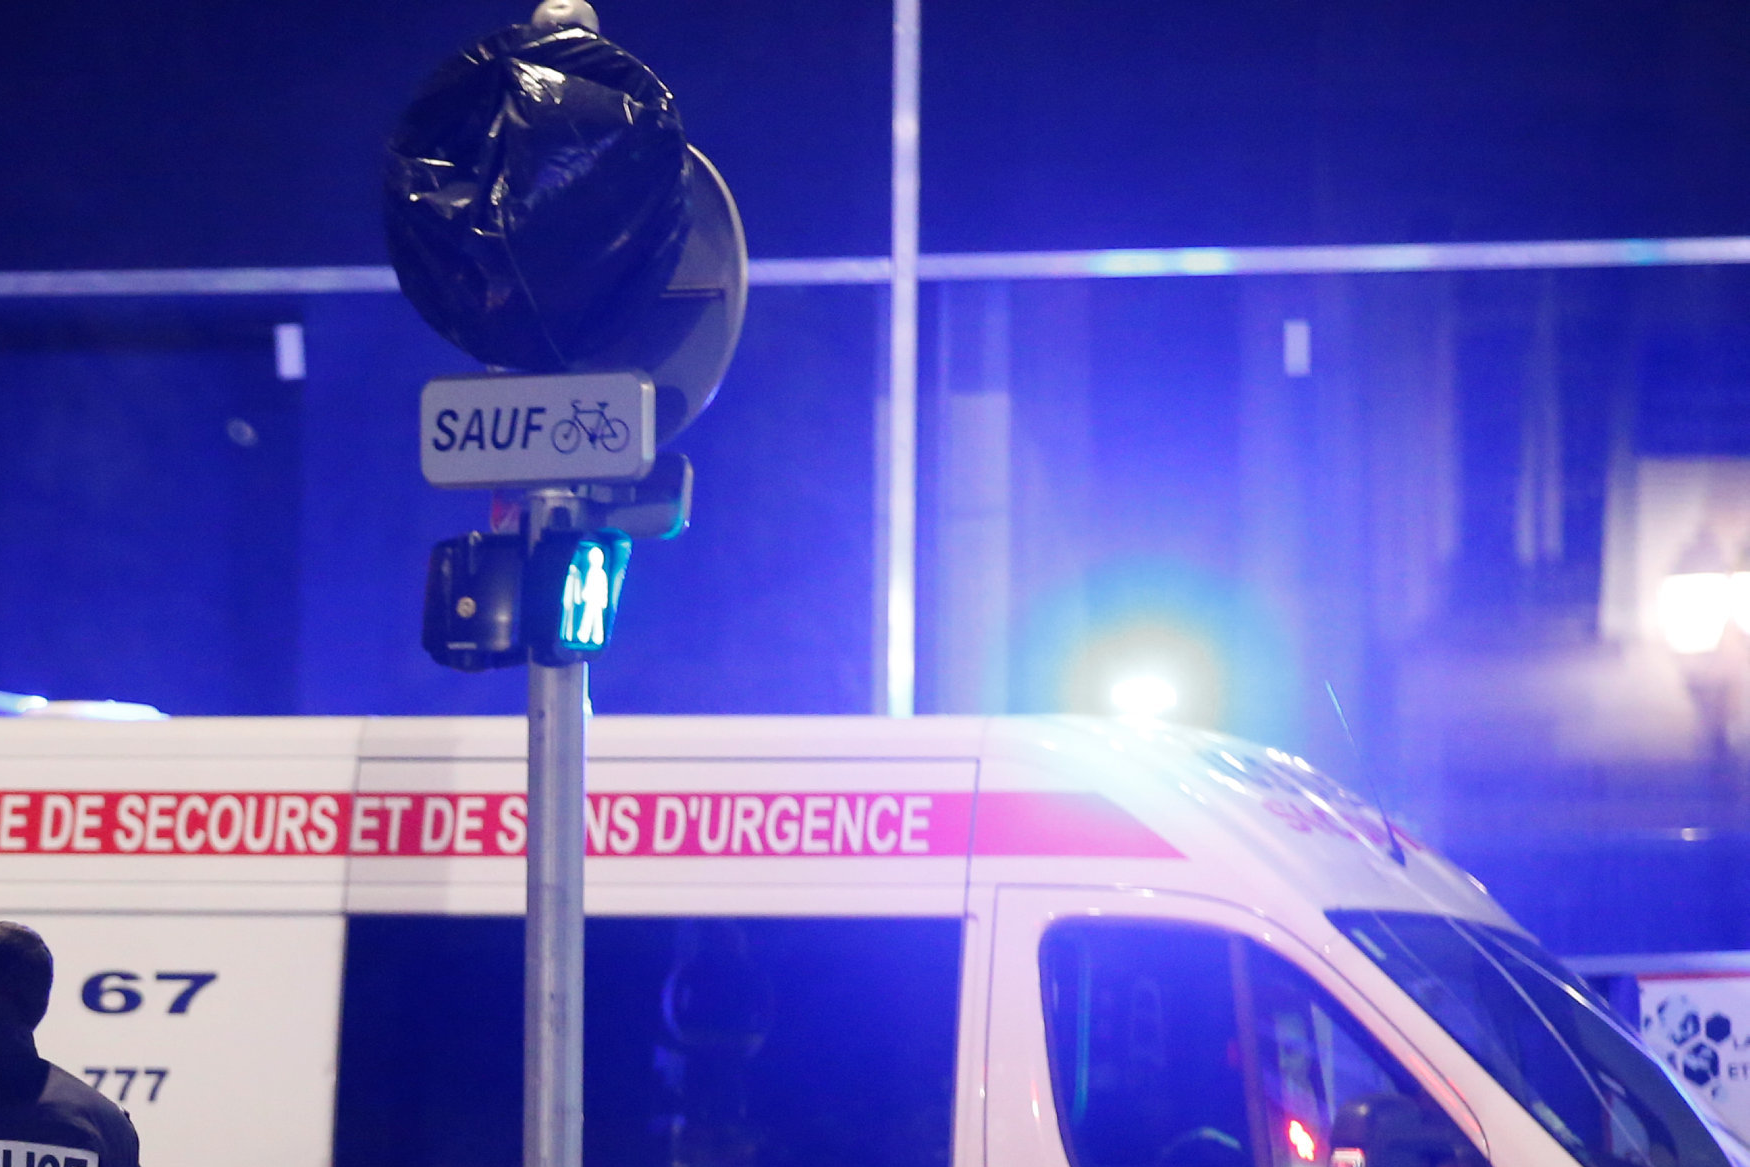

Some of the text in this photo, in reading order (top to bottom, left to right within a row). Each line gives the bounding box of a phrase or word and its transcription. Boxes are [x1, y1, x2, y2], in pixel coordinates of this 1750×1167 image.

[432, 407, 547, 452] SAUF
[40, 795, 102, 851] DE
[113, 795, 339, 853] SECOURS
[350, 797, 412, 853] ET
[421, 797, 483, 853] DE
[496, 795, 641, 853] SNS
[653, 796, 932, 854] D'URGENCE
[81, 970, 218, 1014] 67
[83, 1066, 169, 1101] 777
